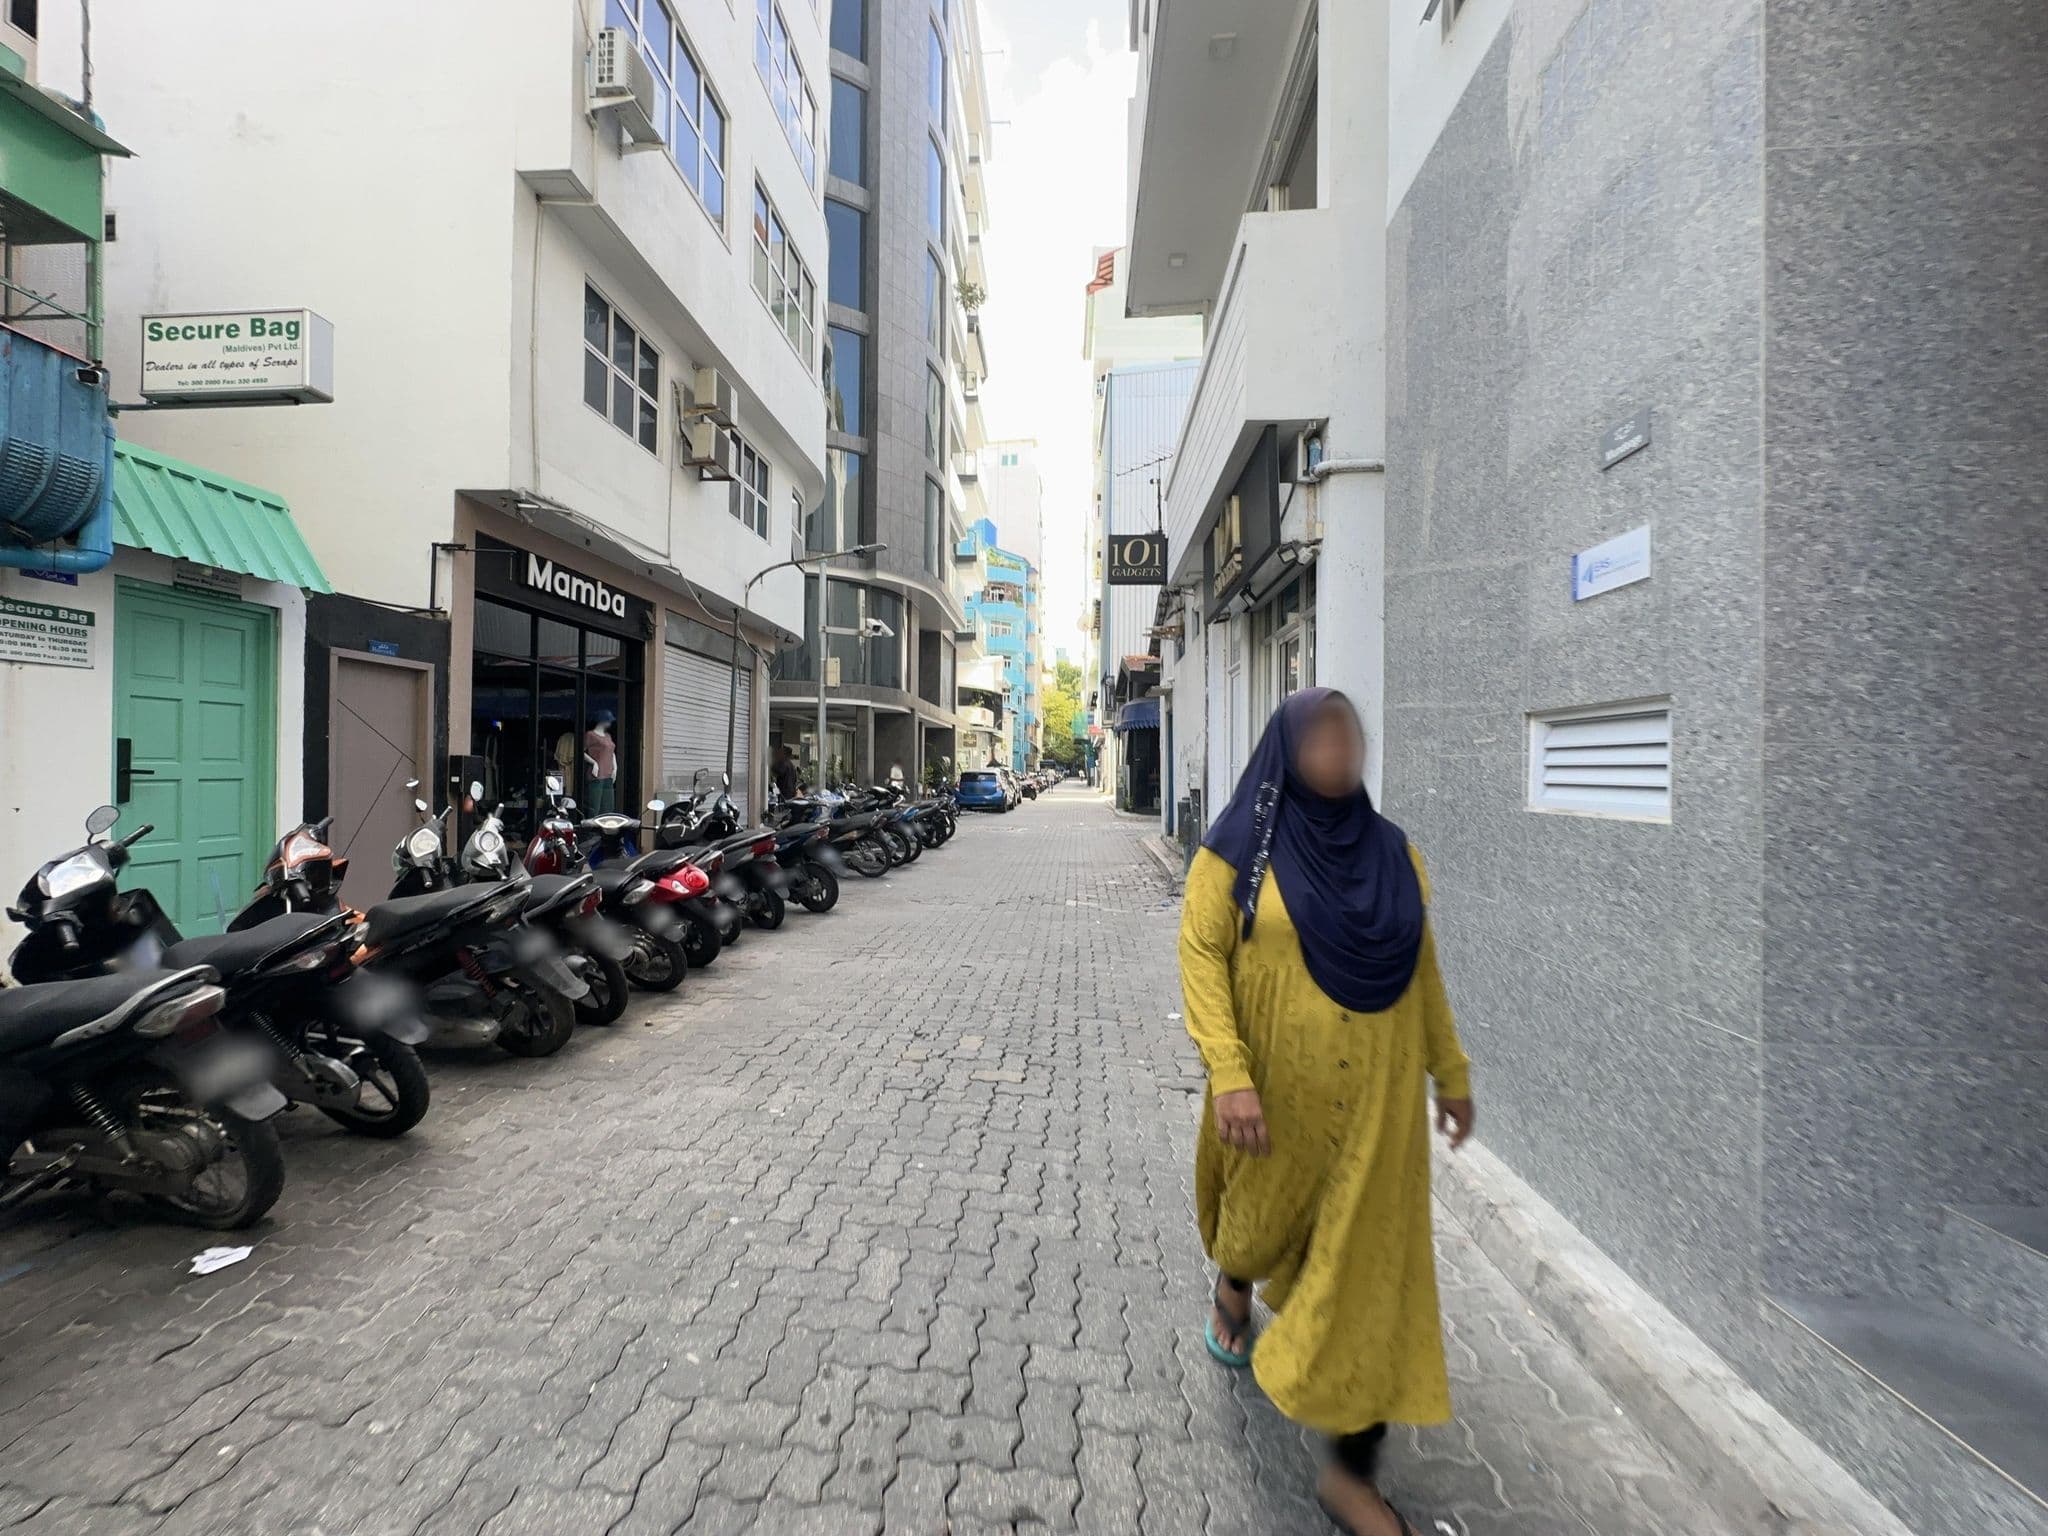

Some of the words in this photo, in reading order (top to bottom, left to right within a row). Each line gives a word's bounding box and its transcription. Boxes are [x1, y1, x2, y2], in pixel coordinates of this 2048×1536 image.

[148, 321, 241, 342] Secure
[249, 317, 300, 341] Bag
[222, 344, 266, 354] (Maldives)
[268, 343, 282, 351] Pvt
[145, 361, 184, 372] Dealers
[188, 362, 198, 370] in
[201, 360, 217, 370] all
[219, 361, 245, 371] types
[249, 358, 260, 370] of
[263, 356, 298, 367] Scraps
[1111, 538, 1161, 567] 101
[1111, 567, 1162, 577] GADGETS
[527, 552, 626, 618] Mamba
[58, 609, 88, 624] Bag
[0, 618, 47, 632] PENING
[50, 625, 88, 637] HOURS
[48, 637, 88, 647] THURSDAY
